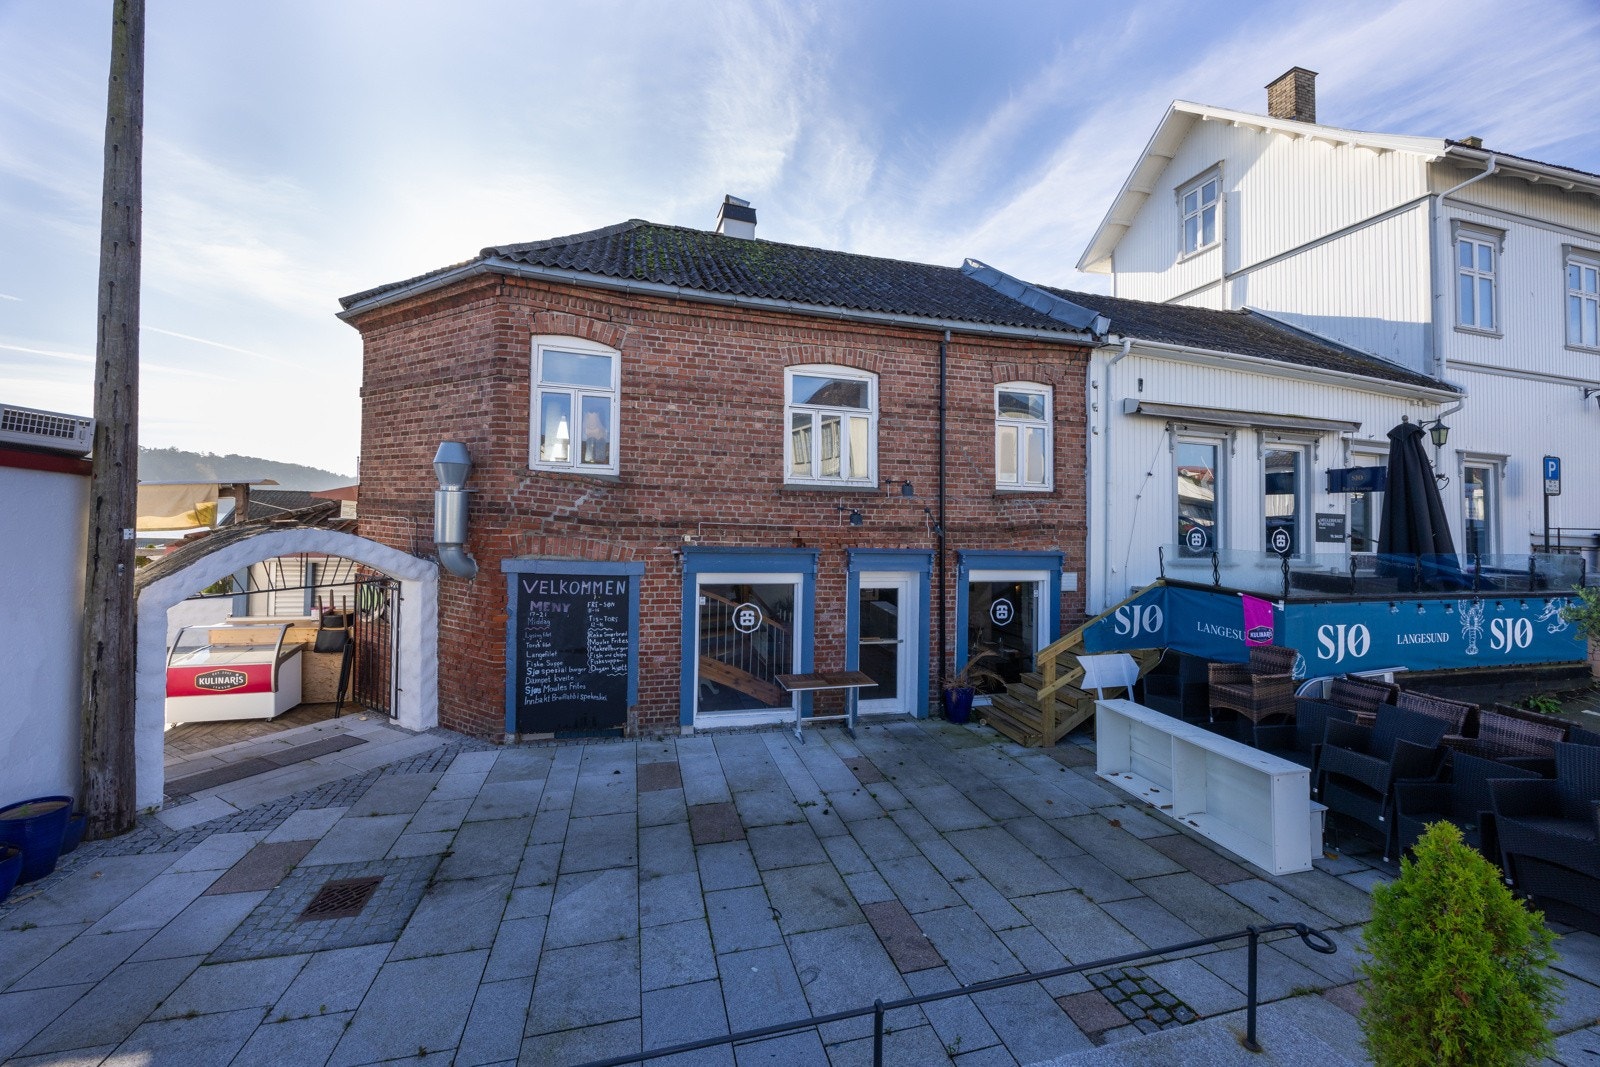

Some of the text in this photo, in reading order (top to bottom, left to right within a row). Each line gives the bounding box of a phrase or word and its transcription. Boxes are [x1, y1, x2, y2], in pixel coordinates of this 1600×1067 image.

[1548, 461, 1557, 478] P
[522, 579, 626, 595] VELKOMMEN
[529, 600, 571, 613] MENY
[527, 617, 551, 627] Middag
[1114, 604, 1164, 638] SJØ
[1197, 621, 1246, 641] LANGESU
[1397, 632, 1449, 645] LANGESUND
[1490, 617, 1533, 654] SJØ
[1317, 623, 1371, 664] SJØ
[543, 683, 568, 694] Moules
